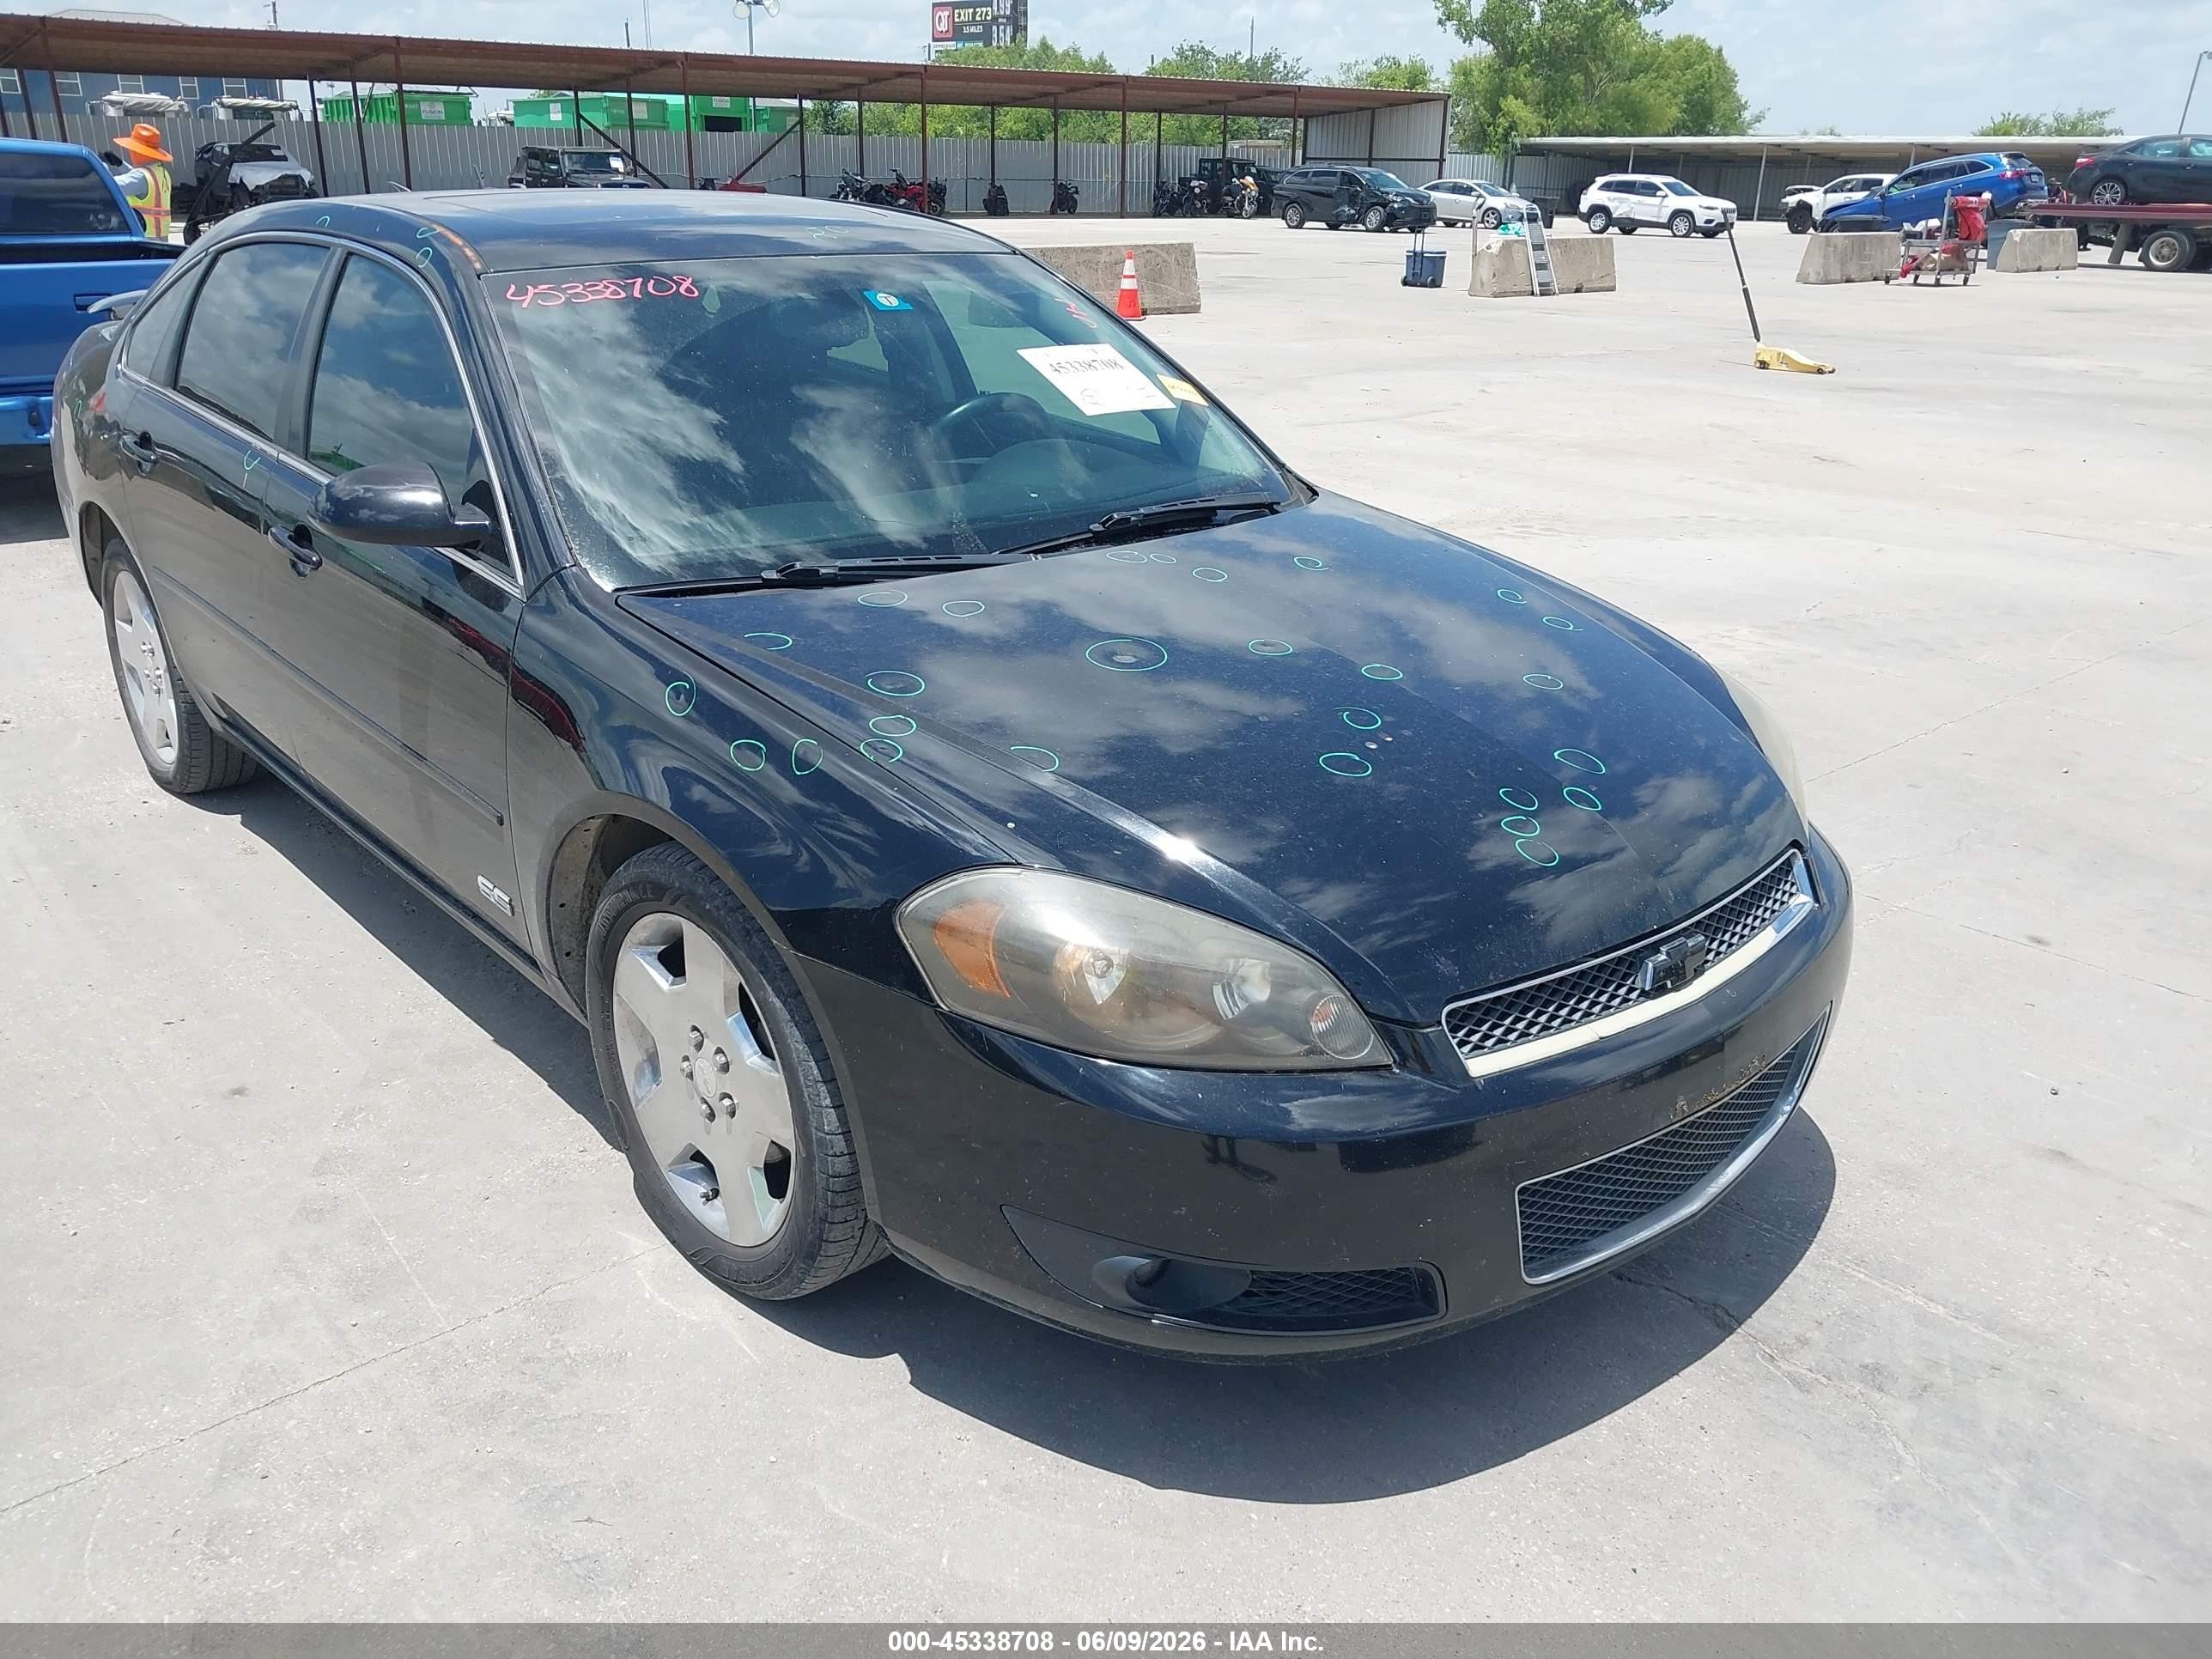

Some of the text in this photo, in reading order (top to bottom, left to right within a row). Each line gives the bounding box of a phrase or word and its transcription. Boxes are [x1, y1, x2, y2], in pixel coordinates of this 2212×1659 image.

[935, 11, 950, 33] QT
[954, 7, 992, 22] EXIT 273
[507, 275, 700, 309] 45338708
[1049, 357, 1125, 374] 45338708
